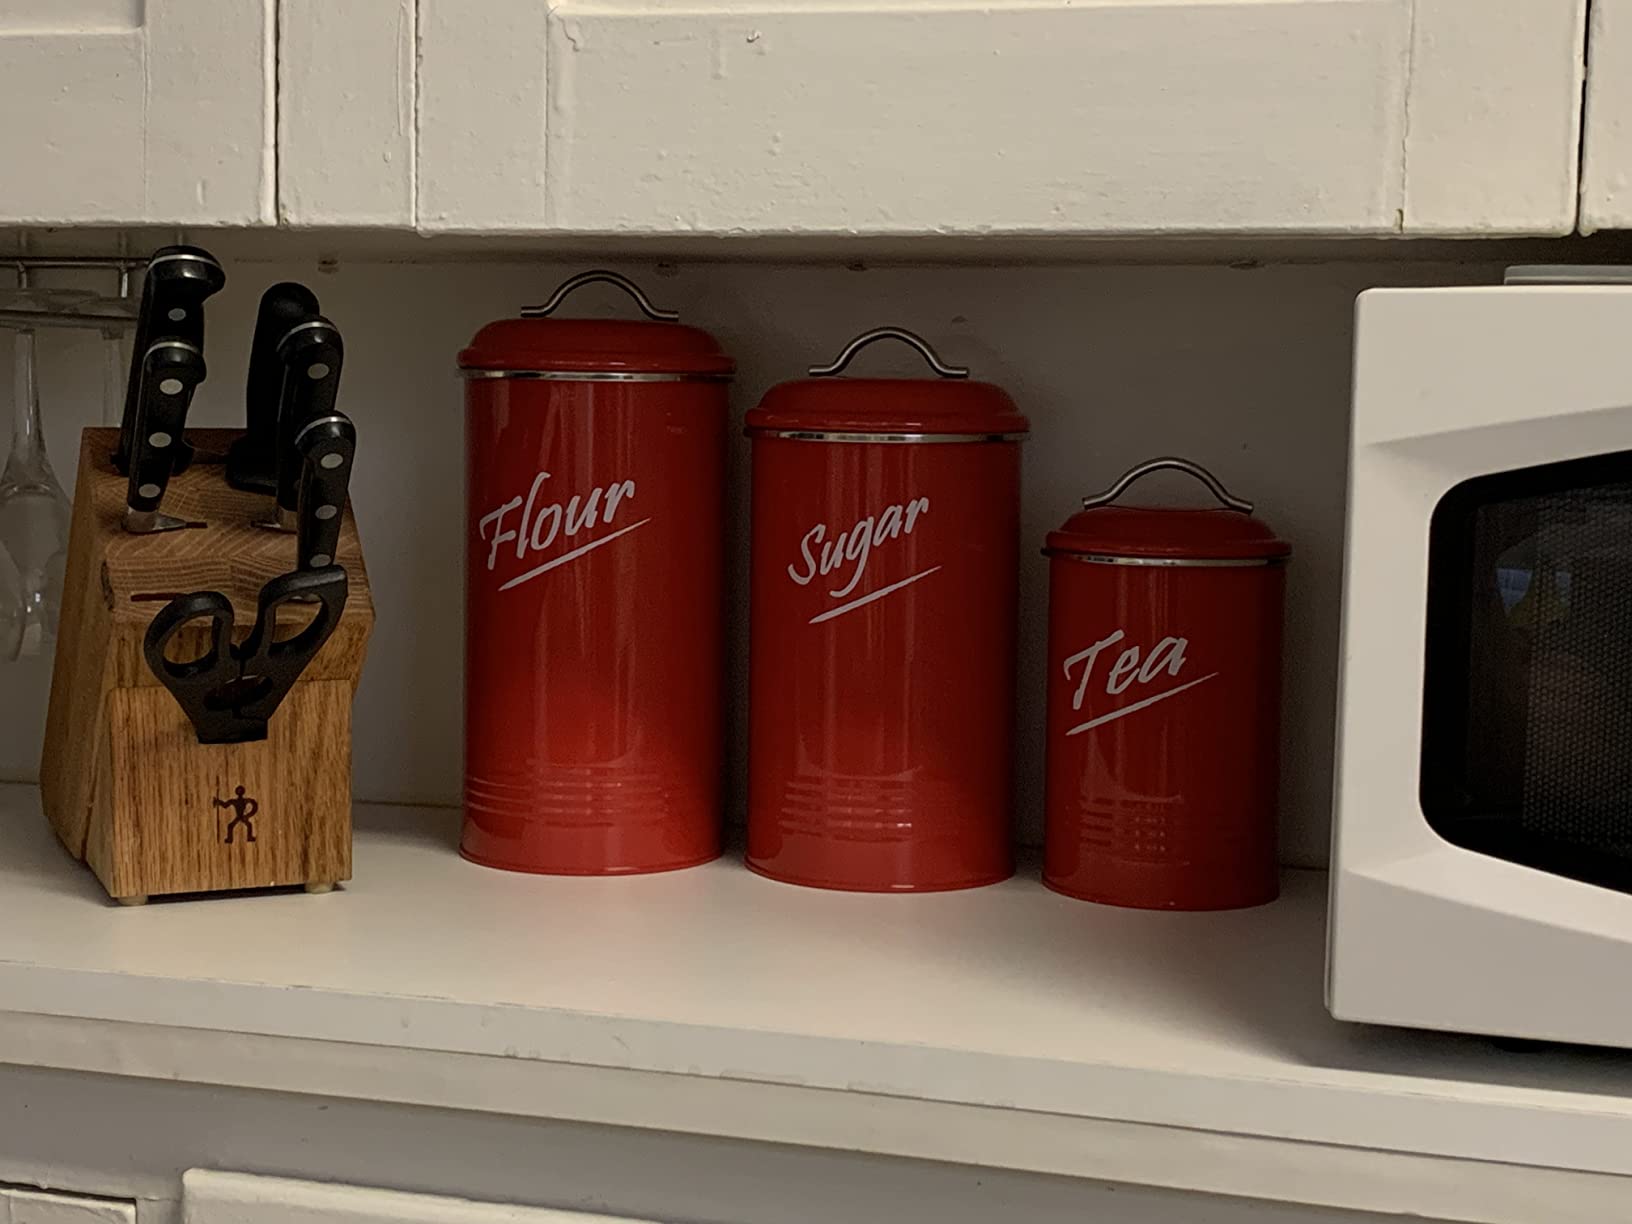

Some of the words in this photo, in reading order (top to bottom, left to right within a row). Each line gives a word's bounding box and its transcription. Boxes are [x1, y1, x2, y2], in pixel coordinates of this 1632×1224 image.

[479, 471, 636, 571] Flour
[787, 496, 930, 598] Sugar
[1062, 628, 1188, 711] Tea
